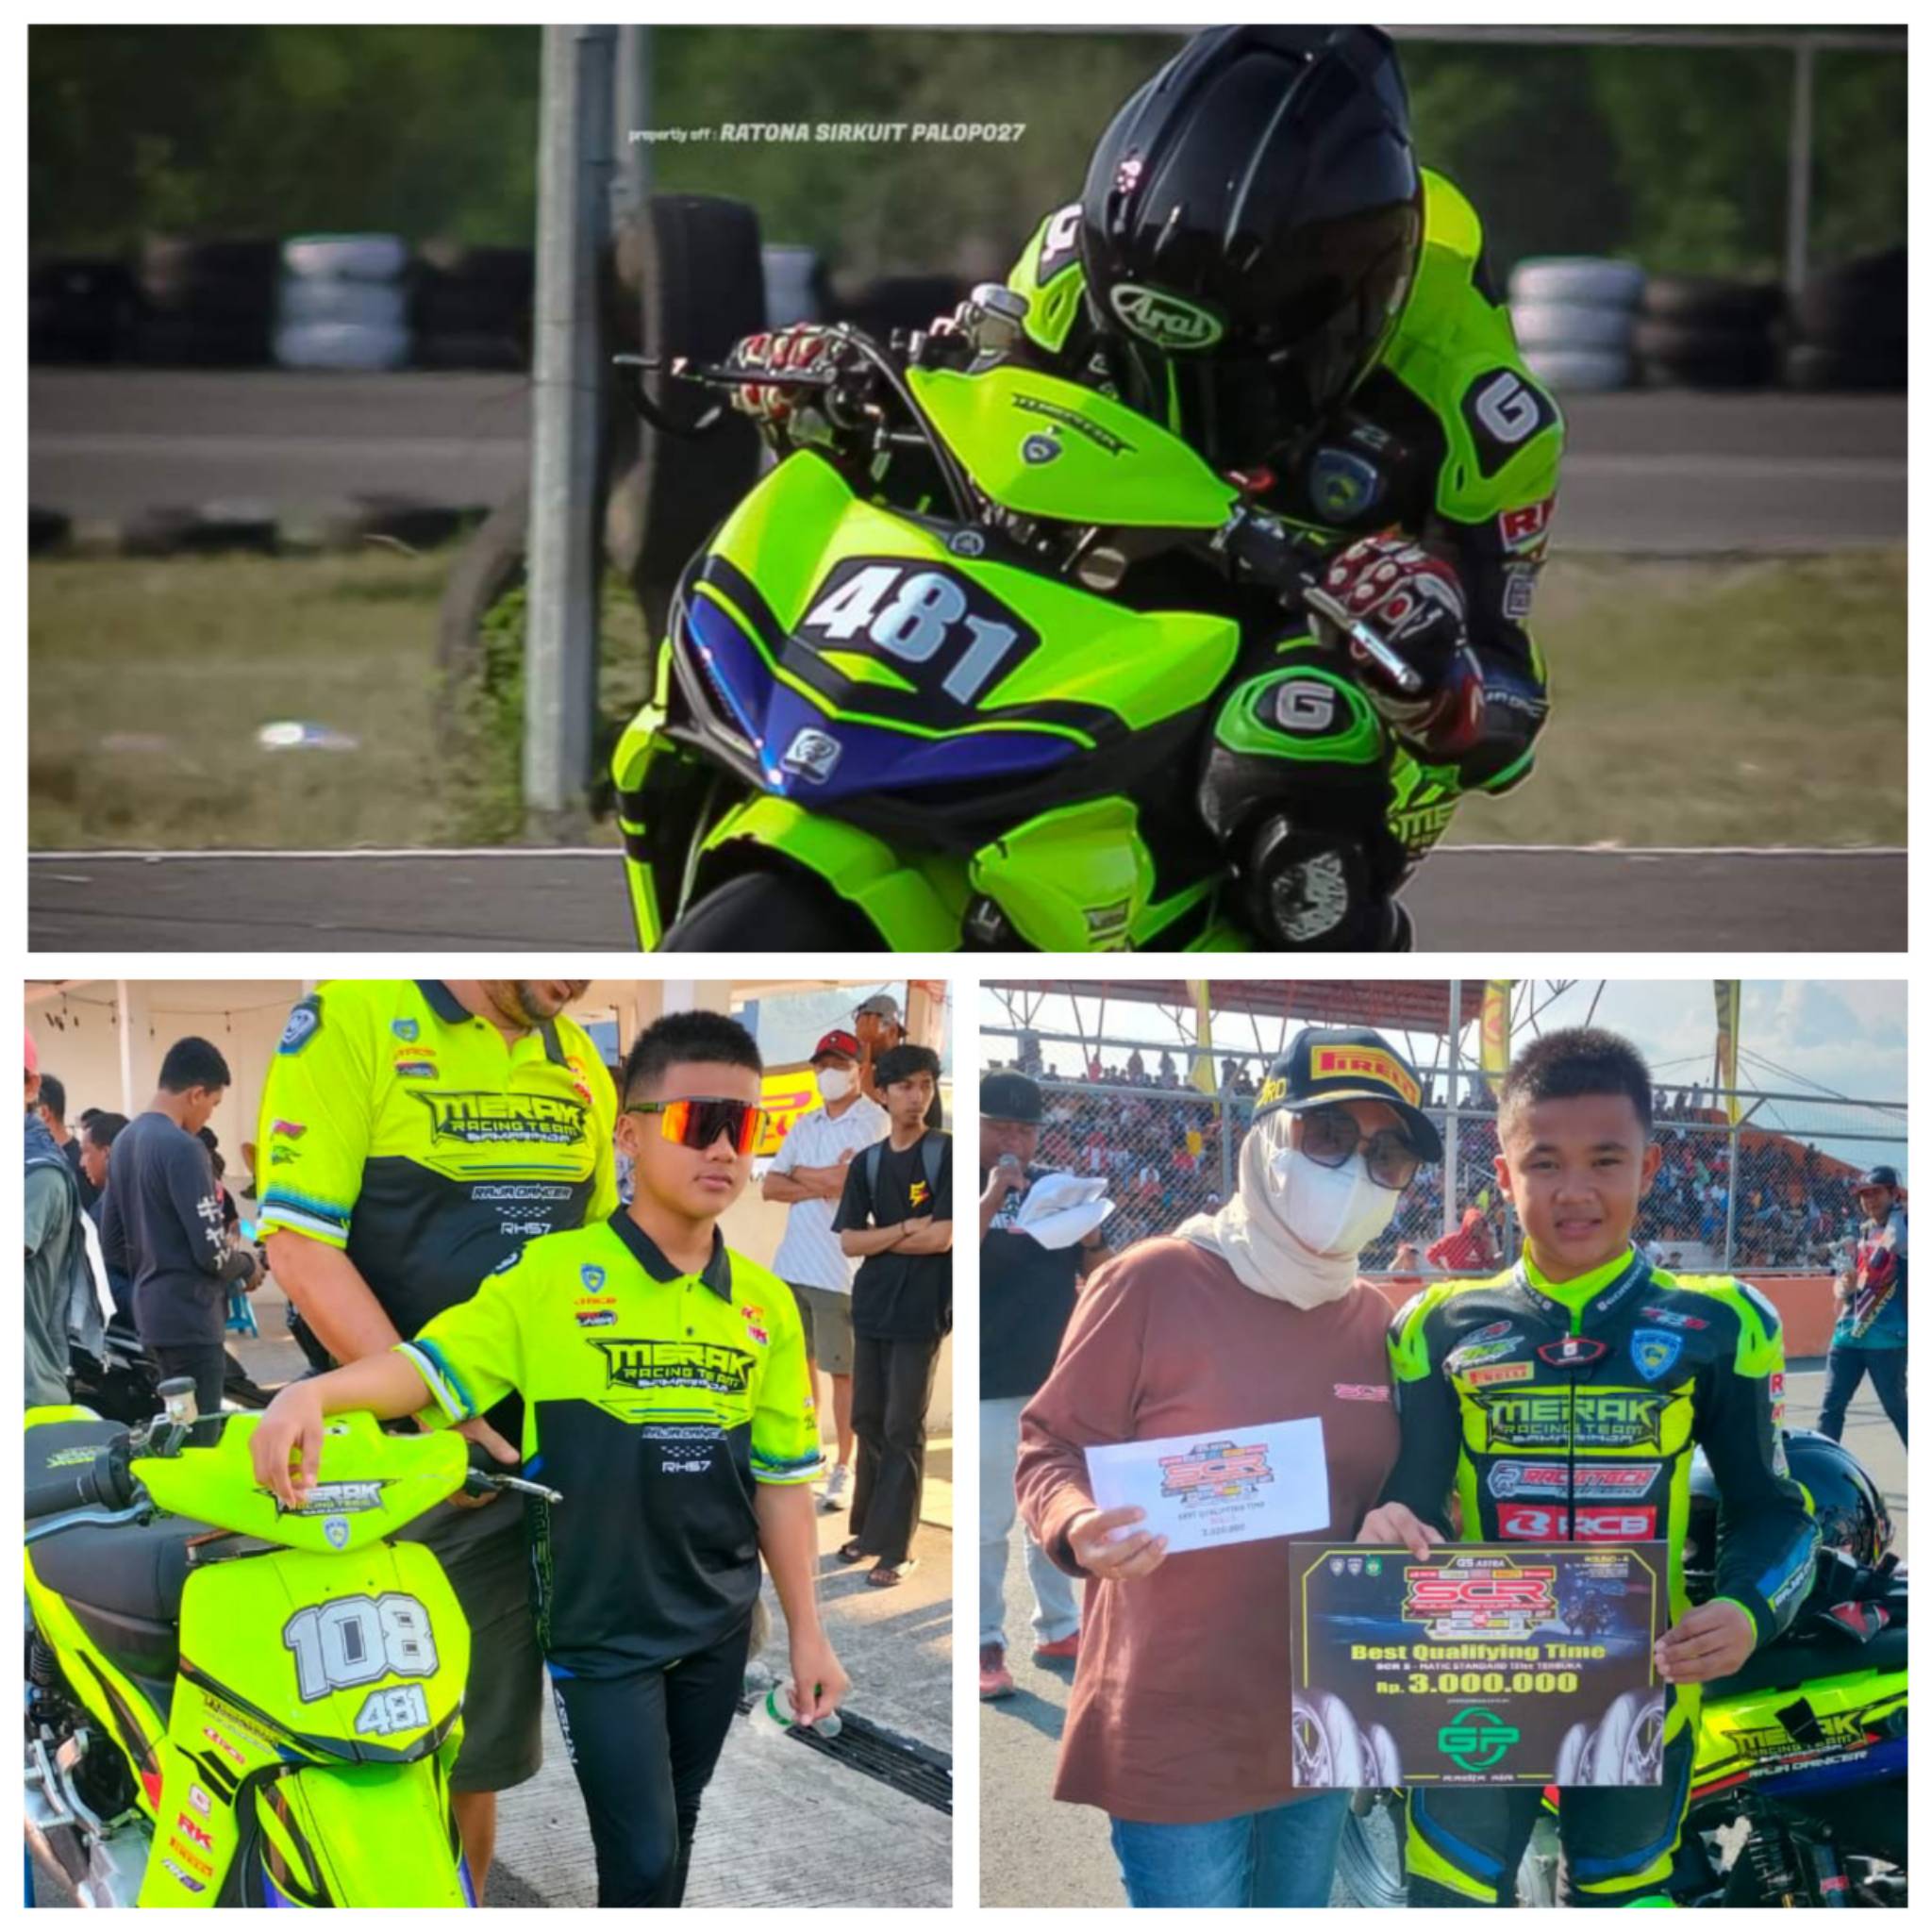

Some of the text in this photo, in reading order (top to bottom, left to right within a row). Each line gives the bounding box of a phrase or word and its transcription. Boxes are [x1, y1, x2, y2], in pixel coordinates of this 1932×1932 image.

[1117, 294, 1204, 337] Arai
[1476, 373, 1540, 443] G
[804, 566, 1017, 705] 481
[1276, 681, 1334, 729] G
[434, 1096, 583, 1130] MERAK
[452, 1121, 578, 1137] RACING TEAM
[601, 1344, 756, 1389] MERAK
[624, 1367, 693, 1378] RACING
[1488, 1399, 1659, 1428] MERAK
[1503, 1424, 1643, 1435] RACING TEAM
[1558, 1515, 1649, 1535] RCB
[1412, 1580, 1552, 1603] SCR
[283, 1592, 439, 1704] 108
[1351, 1644, 1607, 1661] Best Qualifying Time
[1453, 1662, 1507, 1671] STANDARD
[1376, 1673, 1578, 1695] Rp. 3.000.000
[355, 1685, 430, 1735] 481
[1439, 1726, 1520, 1753] GP
[1792, 1750, 1868, 1771] DANCER
